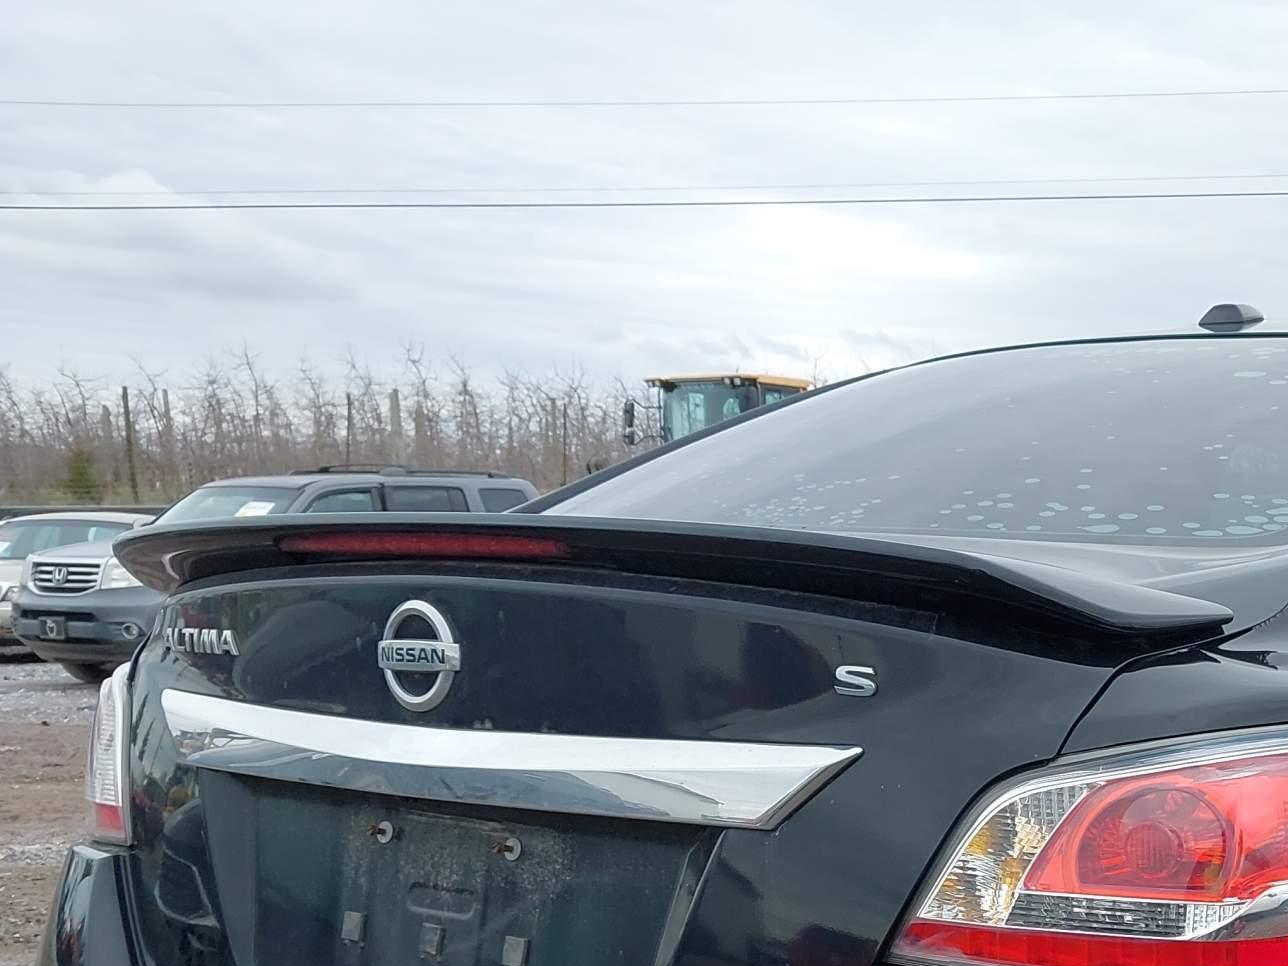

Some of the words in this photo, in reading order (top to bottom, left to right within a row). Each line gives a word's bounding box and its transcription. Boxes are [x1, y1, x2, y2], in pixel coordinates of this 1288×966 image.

[166, 628, 240, 656] ALTIMA
[381, 646, 446, 664] NISSAN
[834, 665, 876, 697] S
